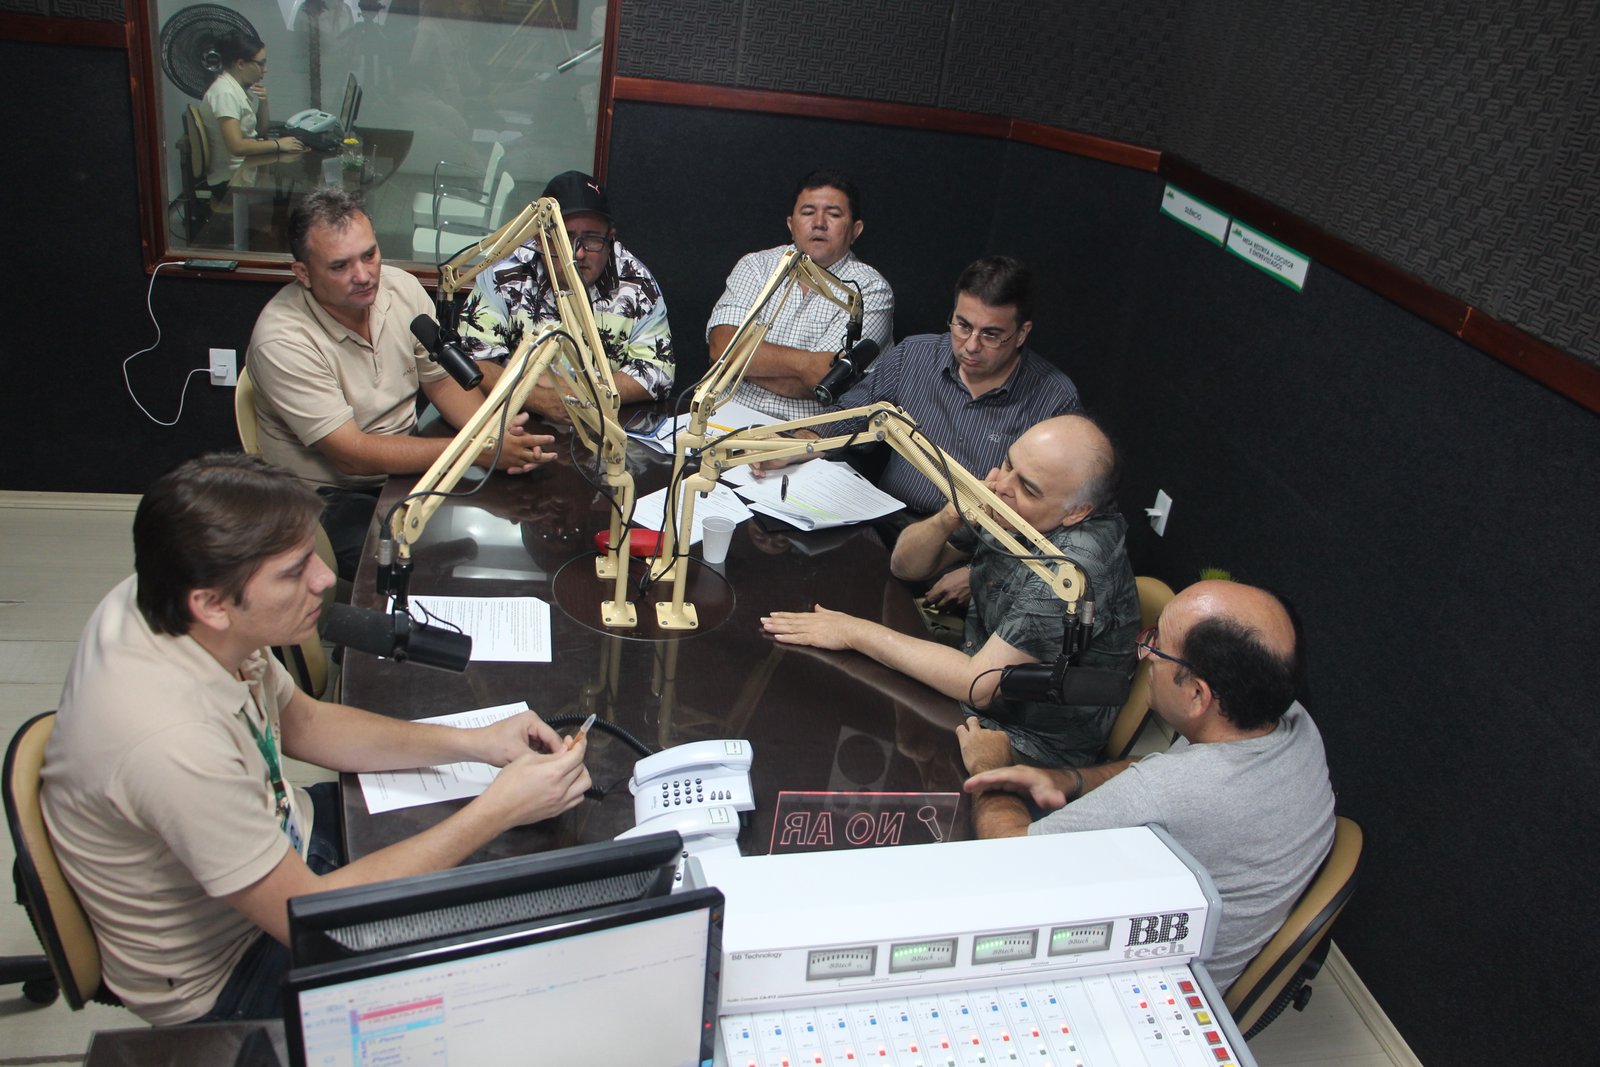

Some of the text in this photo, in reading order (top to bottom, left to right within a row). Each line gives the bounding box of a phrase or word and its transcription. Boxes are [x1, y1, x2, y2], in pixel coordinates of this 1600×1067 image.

[1124, 912, 1190, 948] BB
[744, 951, 783, 962] Technology
[1122, 941, 1185, 960] tech
